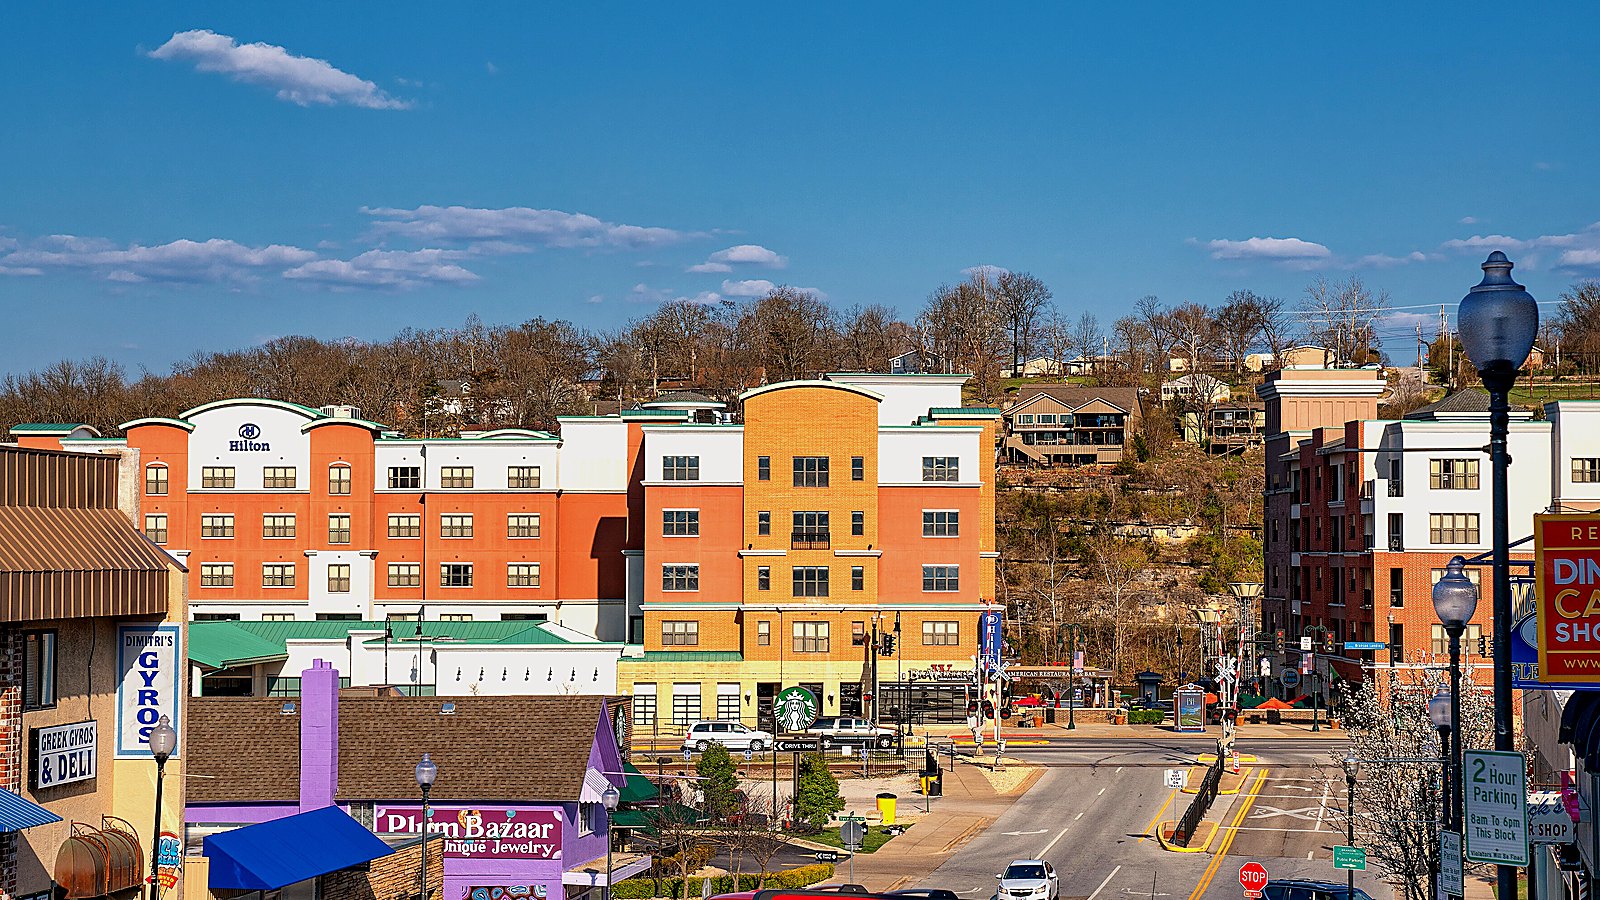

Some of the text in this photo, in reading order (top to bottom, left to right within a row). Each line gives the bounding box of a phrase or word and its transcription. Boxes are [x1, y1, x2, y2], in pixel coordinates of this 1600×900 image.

[229, 440, 270, 452] Hilton
[125, 635, 173, 647] DIMITRI'S
[136, 651, 160, 744] GYROS
[41, 726, 94, 751] GREEK GYROS
[41, 750, 92, 784] & DELI
[1472, 758, 1517, 786] 2 Hour
[1473, 786, 1517, 810] Parking
[464, 815, 554, 840] Bazaar
[1470, 813, 1520, 829] 8am To 6pm
[1475, 827, 1517, 841] This Block
[1538, 824, 1568, 837] SHOP
[491, 841, 555, 858] Jewelry
[1443, 834, 1449, 849] 2
[157, 855, 180, 866] REAM
[1241, 870, 1266, 883] STOP
